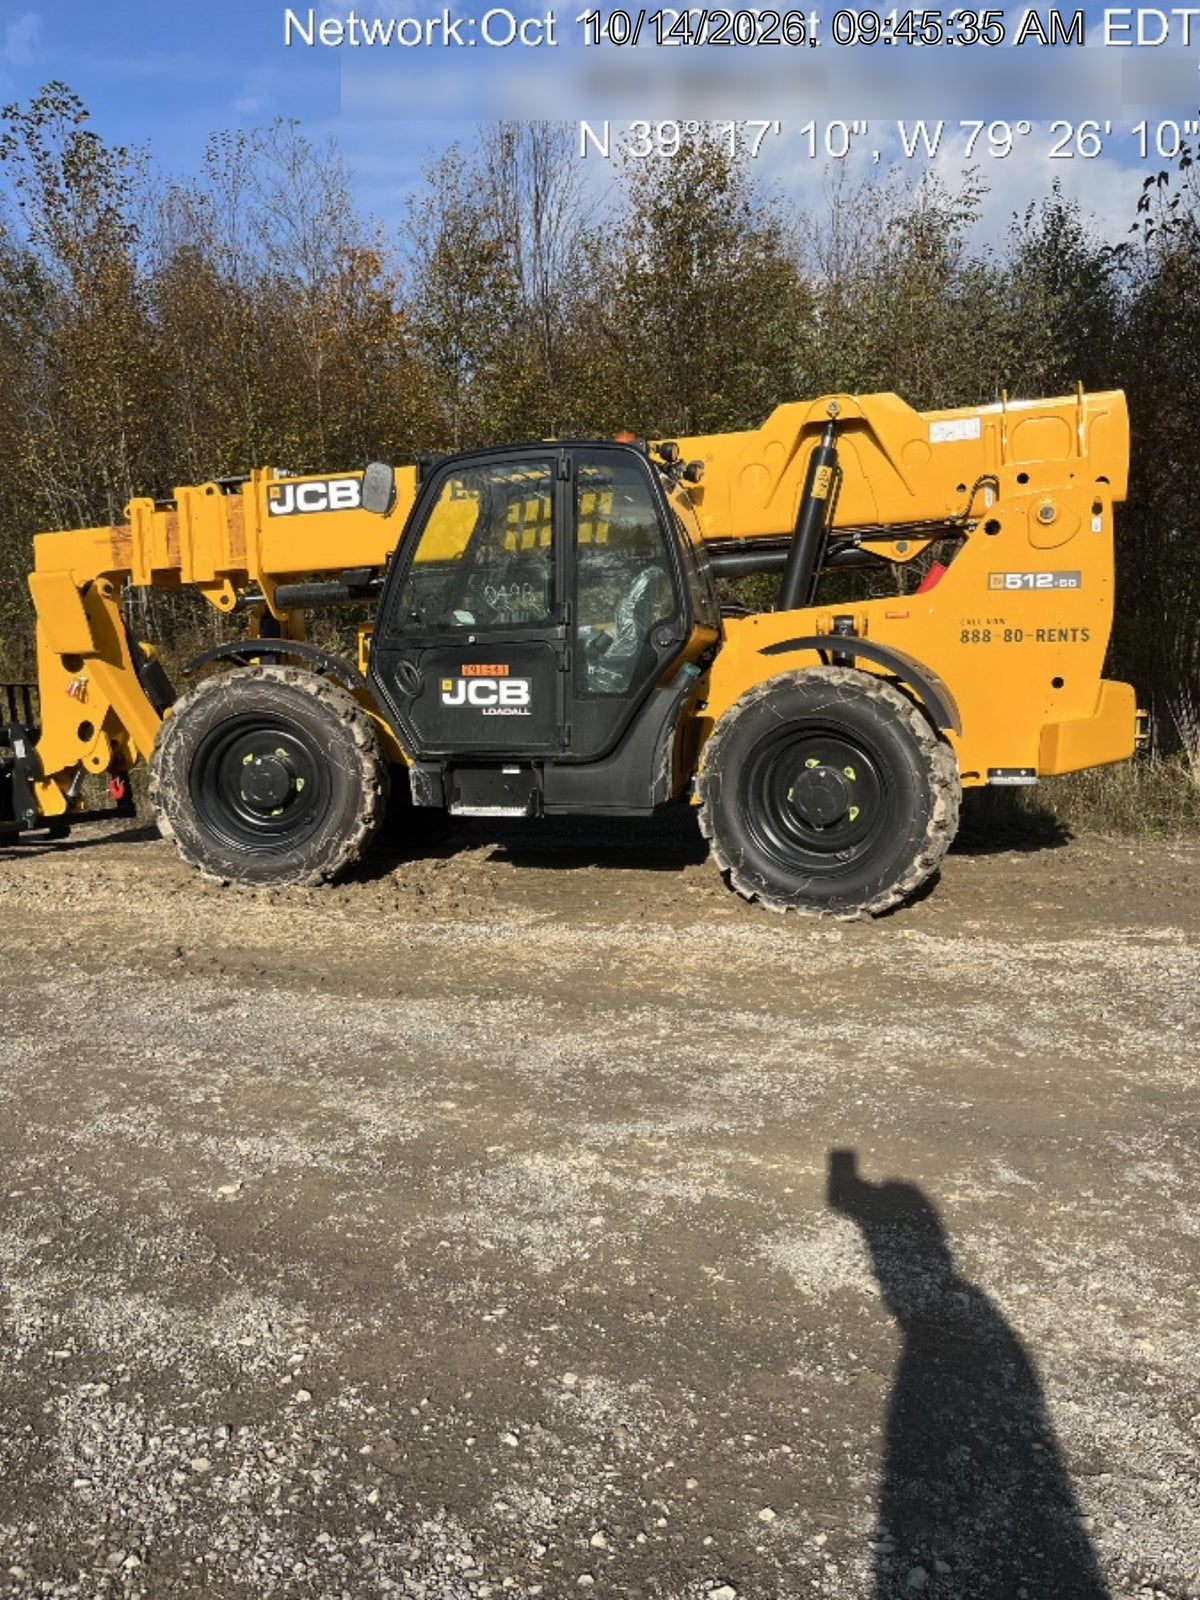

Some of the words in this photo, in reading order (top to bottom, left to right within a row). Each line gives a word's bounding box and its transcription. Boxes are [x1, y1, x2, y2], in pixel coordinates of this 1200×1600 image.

[269, 479, 361, 515] JCB
[441, 679, 531, 706] JCB
[482, 707, 533, 717] LOADALL
